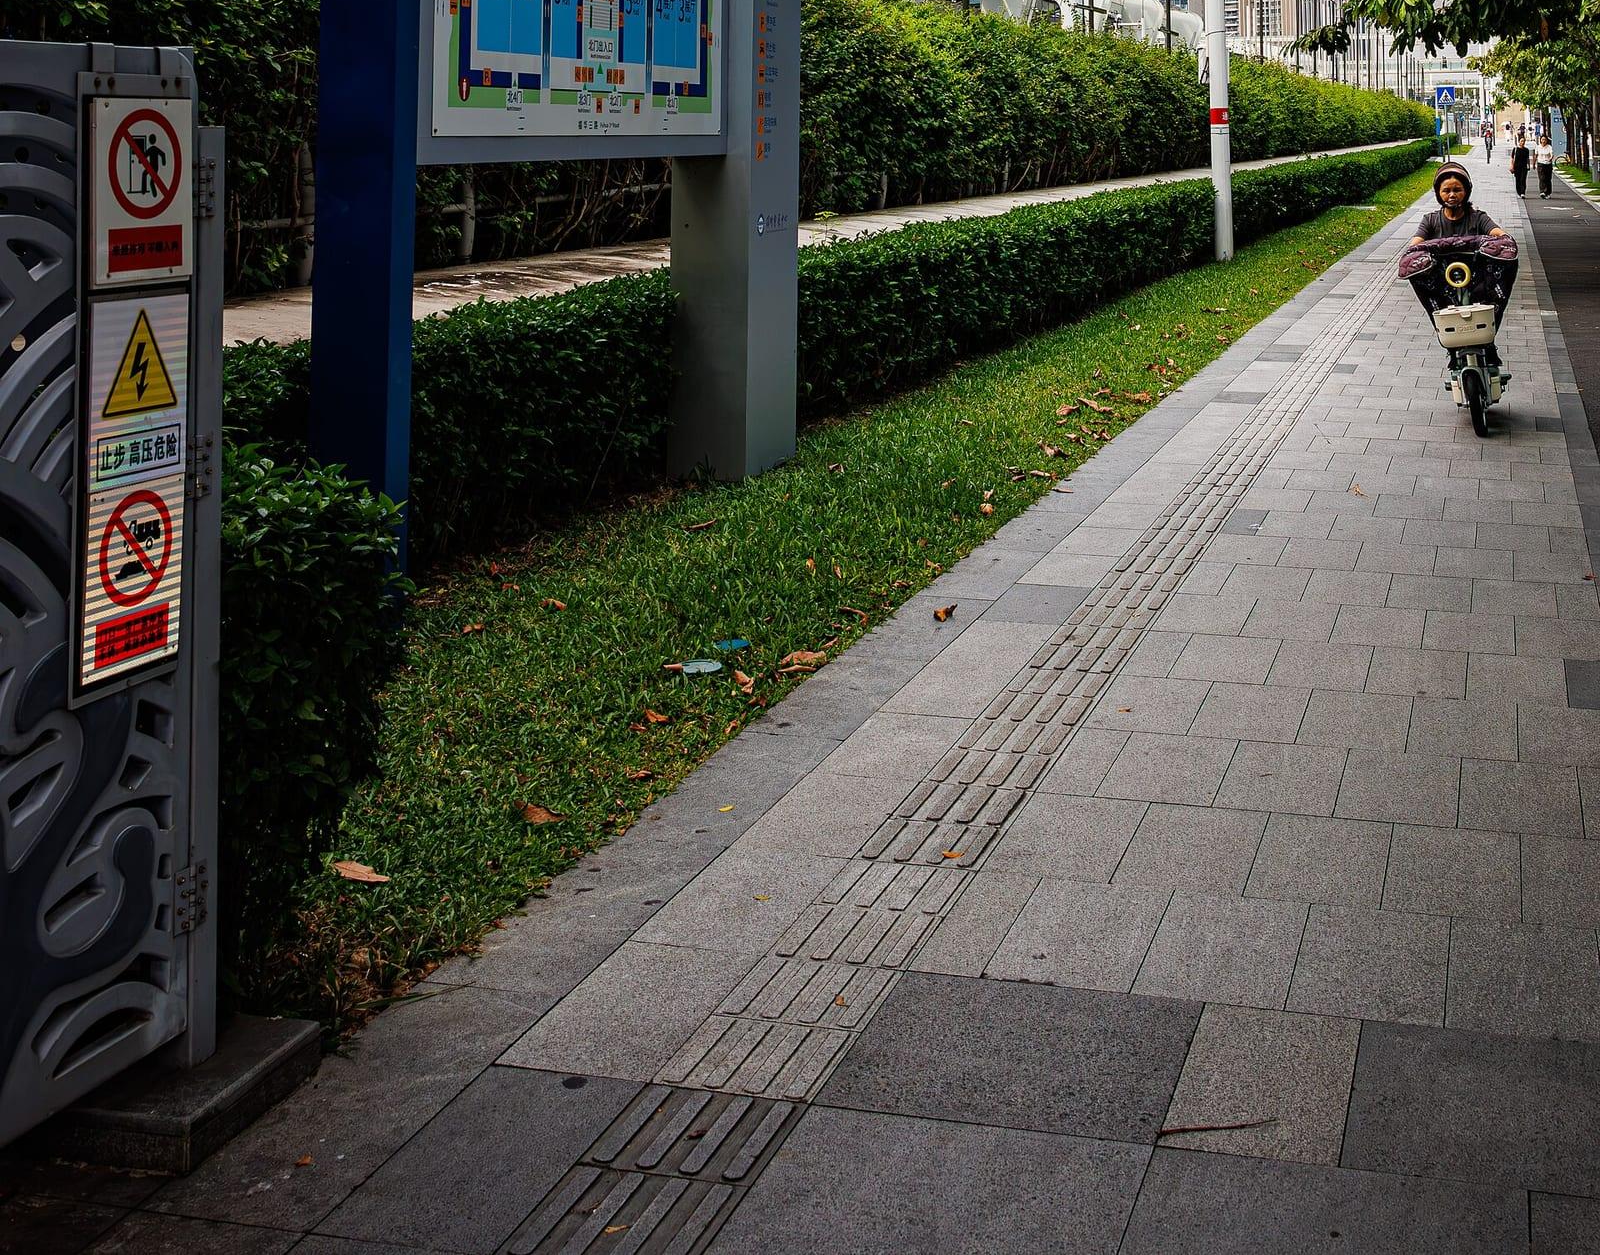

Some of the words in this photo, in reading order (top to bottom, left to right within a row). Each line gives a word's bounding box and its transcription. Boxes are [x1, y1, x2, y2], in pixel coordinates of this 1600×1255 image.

[507, 90, 522, 104] 北4门
[100, 443, 126, 471] 止步
[129, 432, 177, 467] 高压危险
